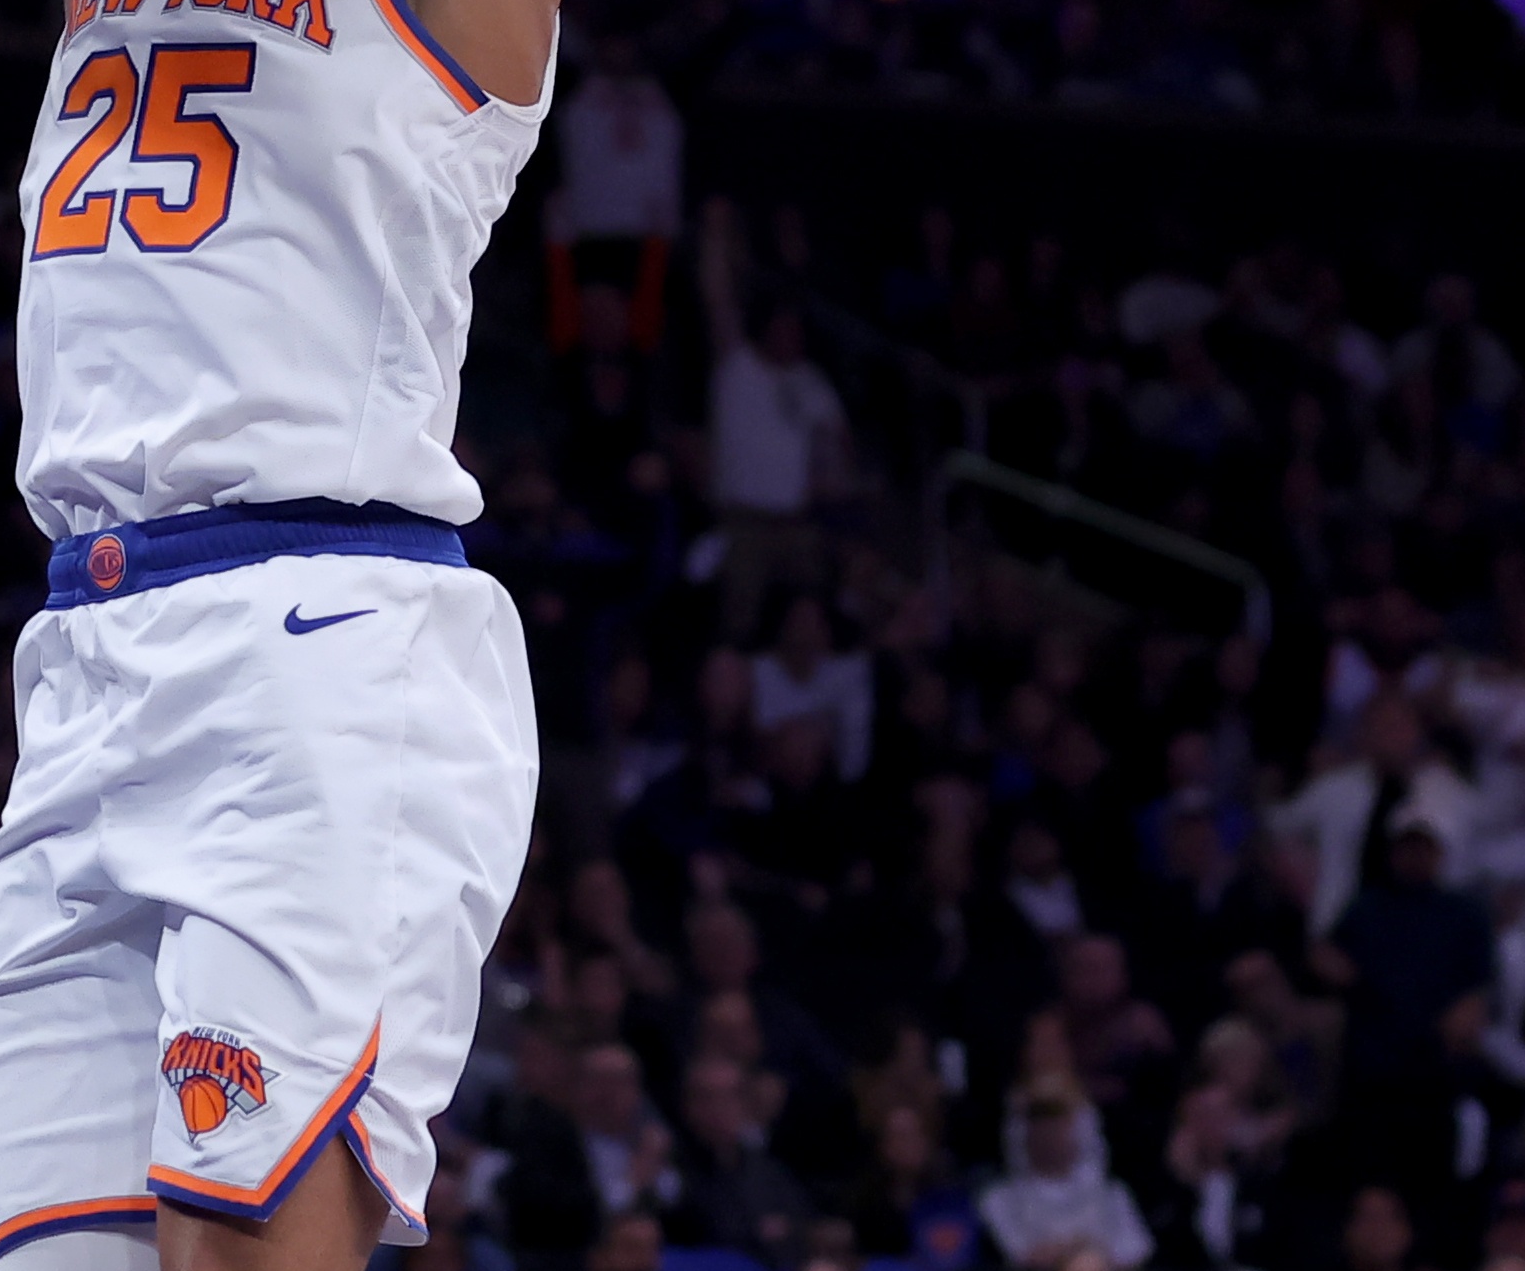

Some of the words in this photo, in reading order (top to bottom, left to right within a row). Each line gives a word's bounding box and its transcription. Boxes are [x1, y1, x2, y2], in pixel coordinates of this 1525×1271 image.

[30, 41, 257, 262] 25
[161, 1031, 267, 1105] KNICKS
[216, 1029, 241, 1049] YORK
